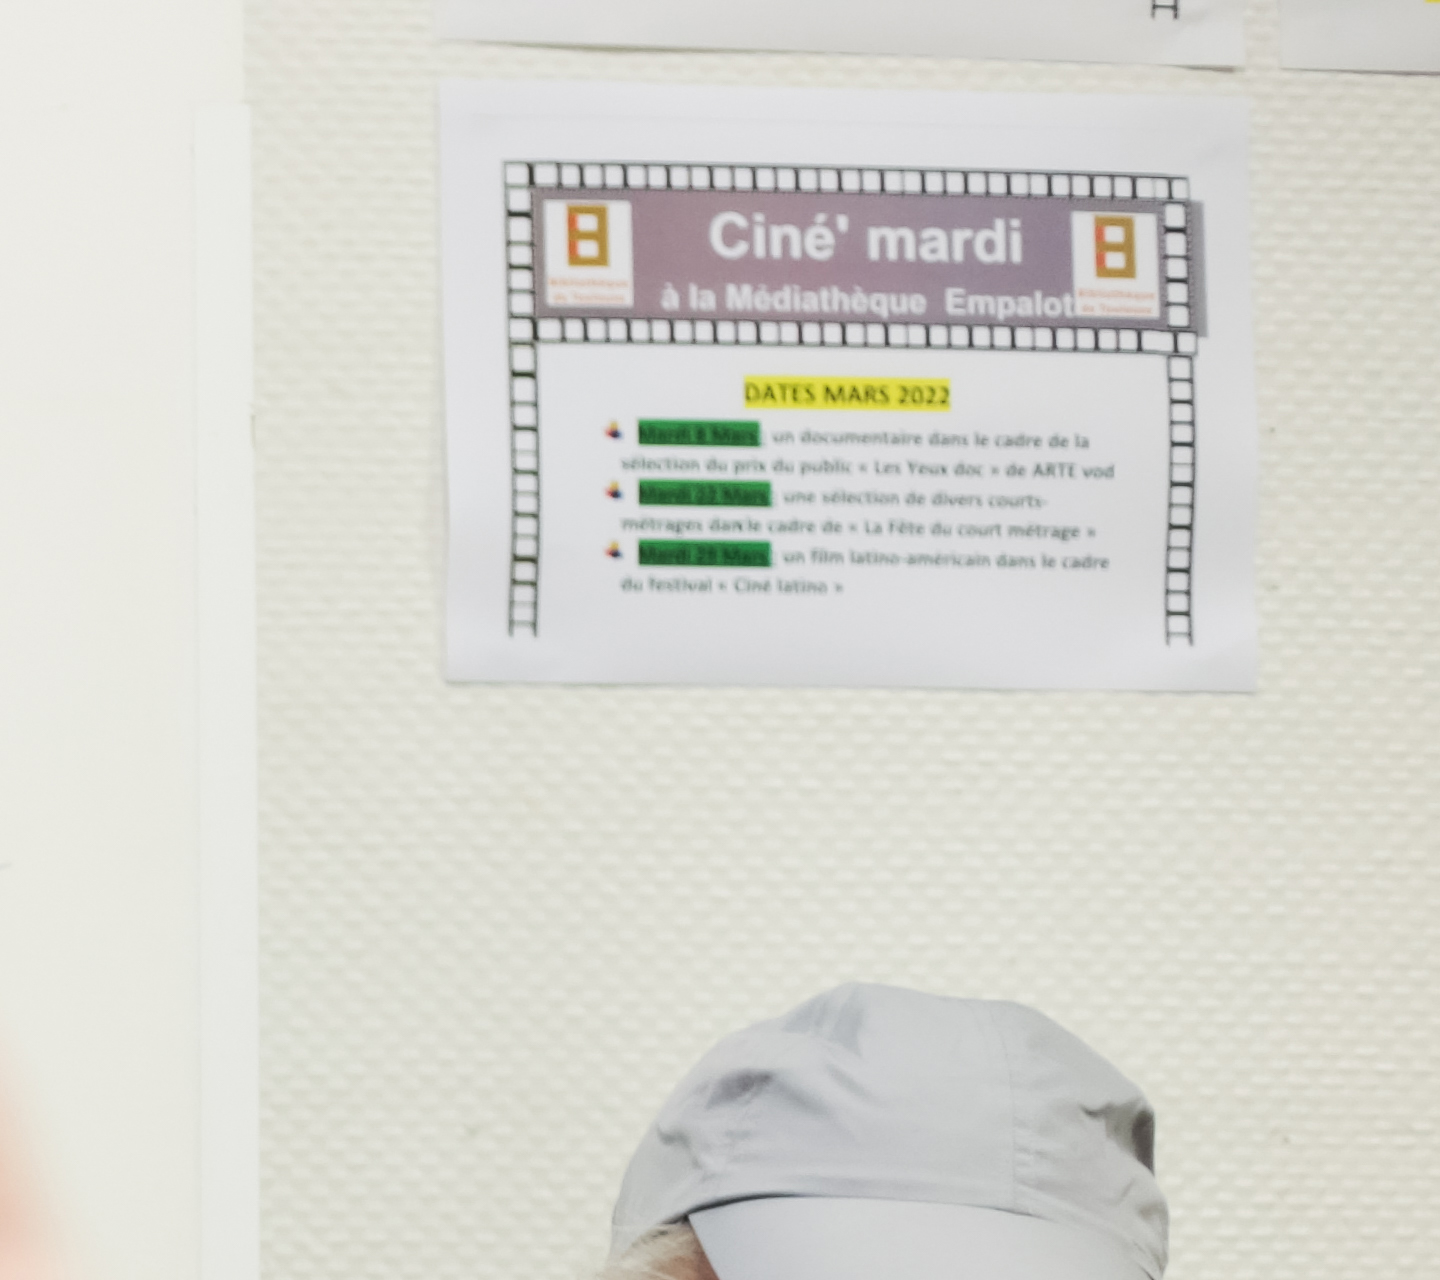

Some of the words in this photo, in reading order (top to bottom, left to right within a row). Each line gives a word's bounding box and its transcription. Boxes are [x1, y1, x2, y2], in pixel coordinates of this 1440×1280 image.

[867, 217, 1023, 264] mardi
[661, 282, 680, 311] à
[689, 282, 716, 312] la
[726, 283, 927, 318] Médiathèque
[945, 287, 1077, 320] Empalot
[745, 382, 815, 403] DATES
[824, 383, 890, 404] MARS
[898, 385, 950, 405] 2022
